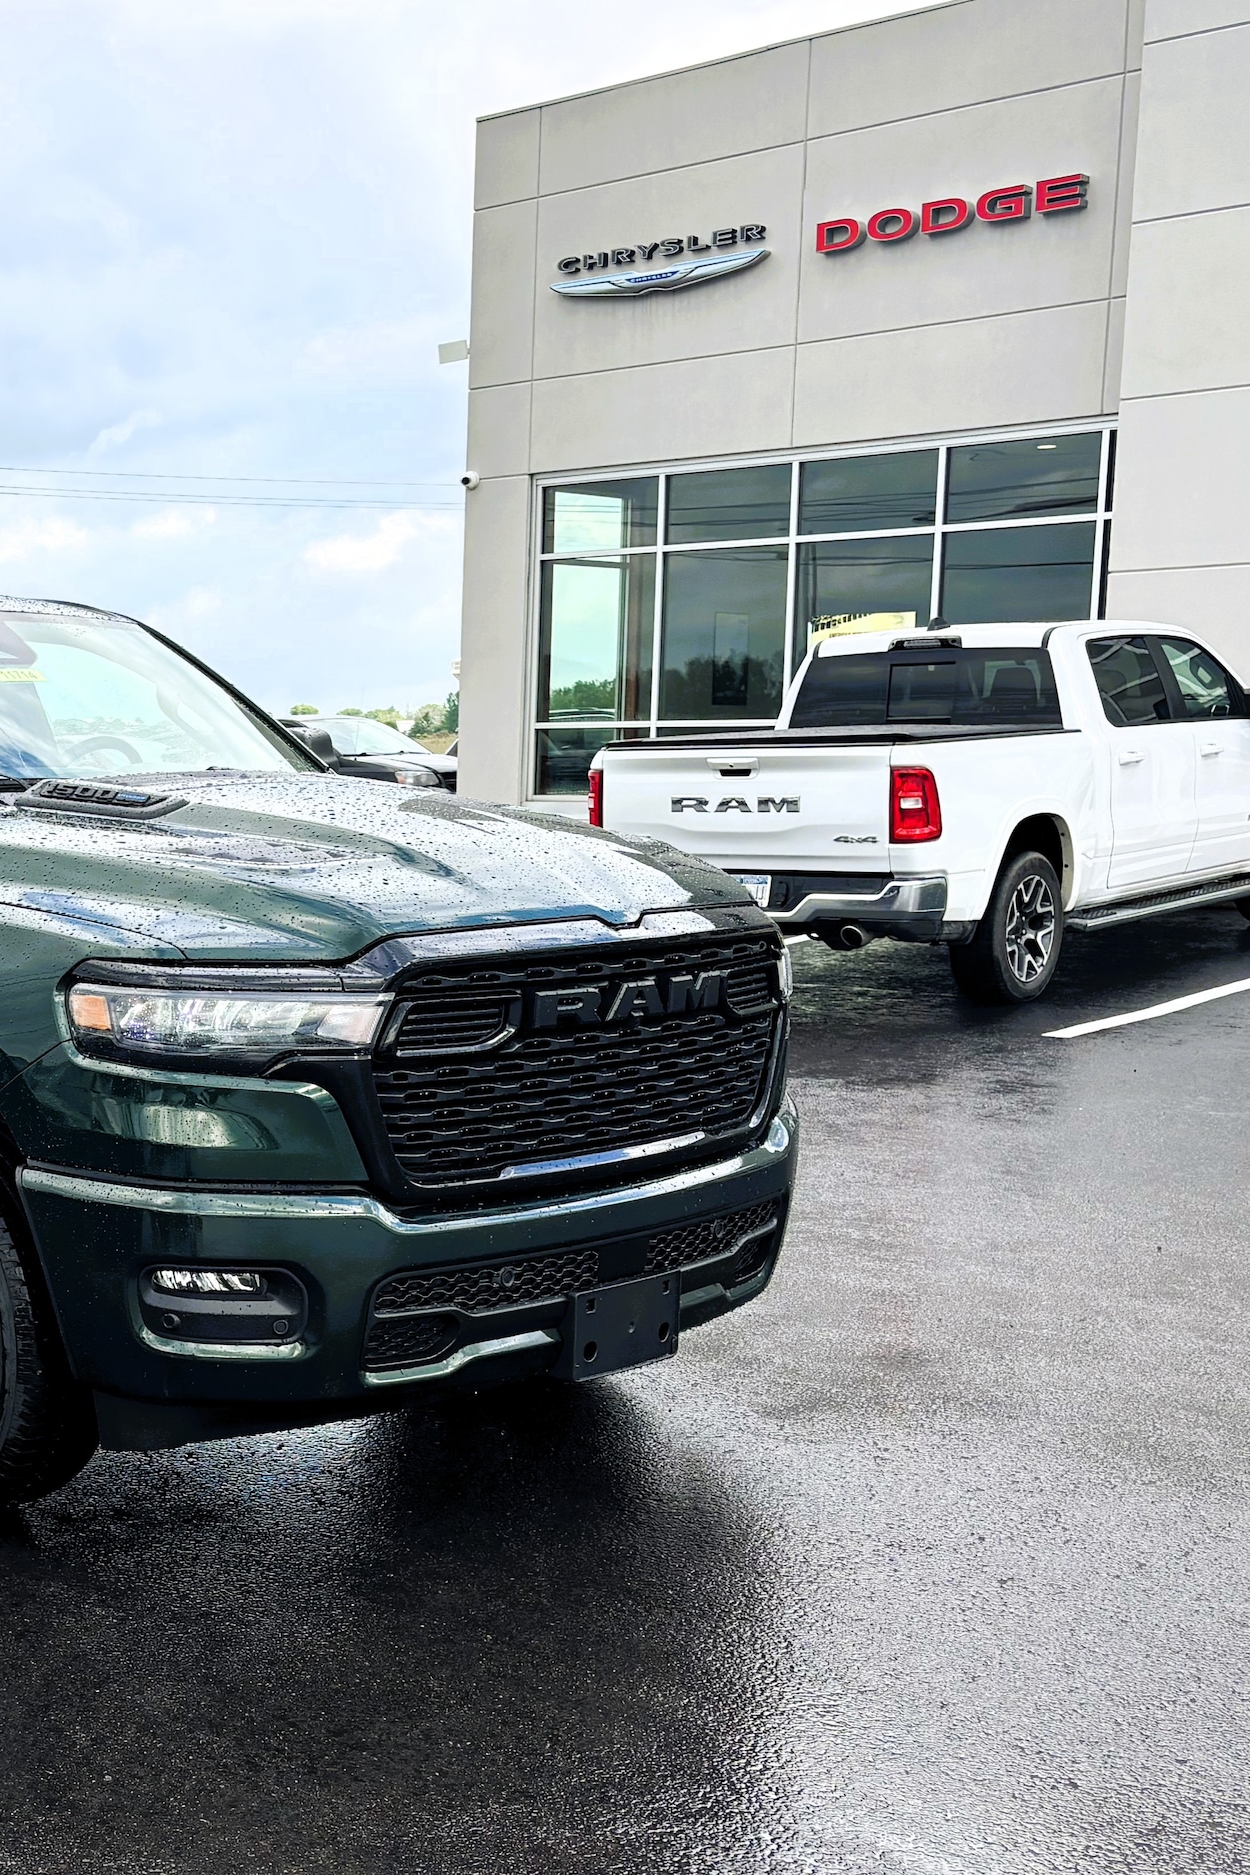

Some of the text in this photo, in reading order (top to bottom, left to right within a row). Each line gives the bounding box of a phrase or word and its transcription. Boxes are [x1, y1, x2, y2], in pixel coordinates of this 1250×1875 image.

[816, 173, 1090, 254] DODGE
[557, 223, 767, 273] CHRYSLER
[671, 796, 801, 813] RAM
[535, 969, 725, 1028] RAM
